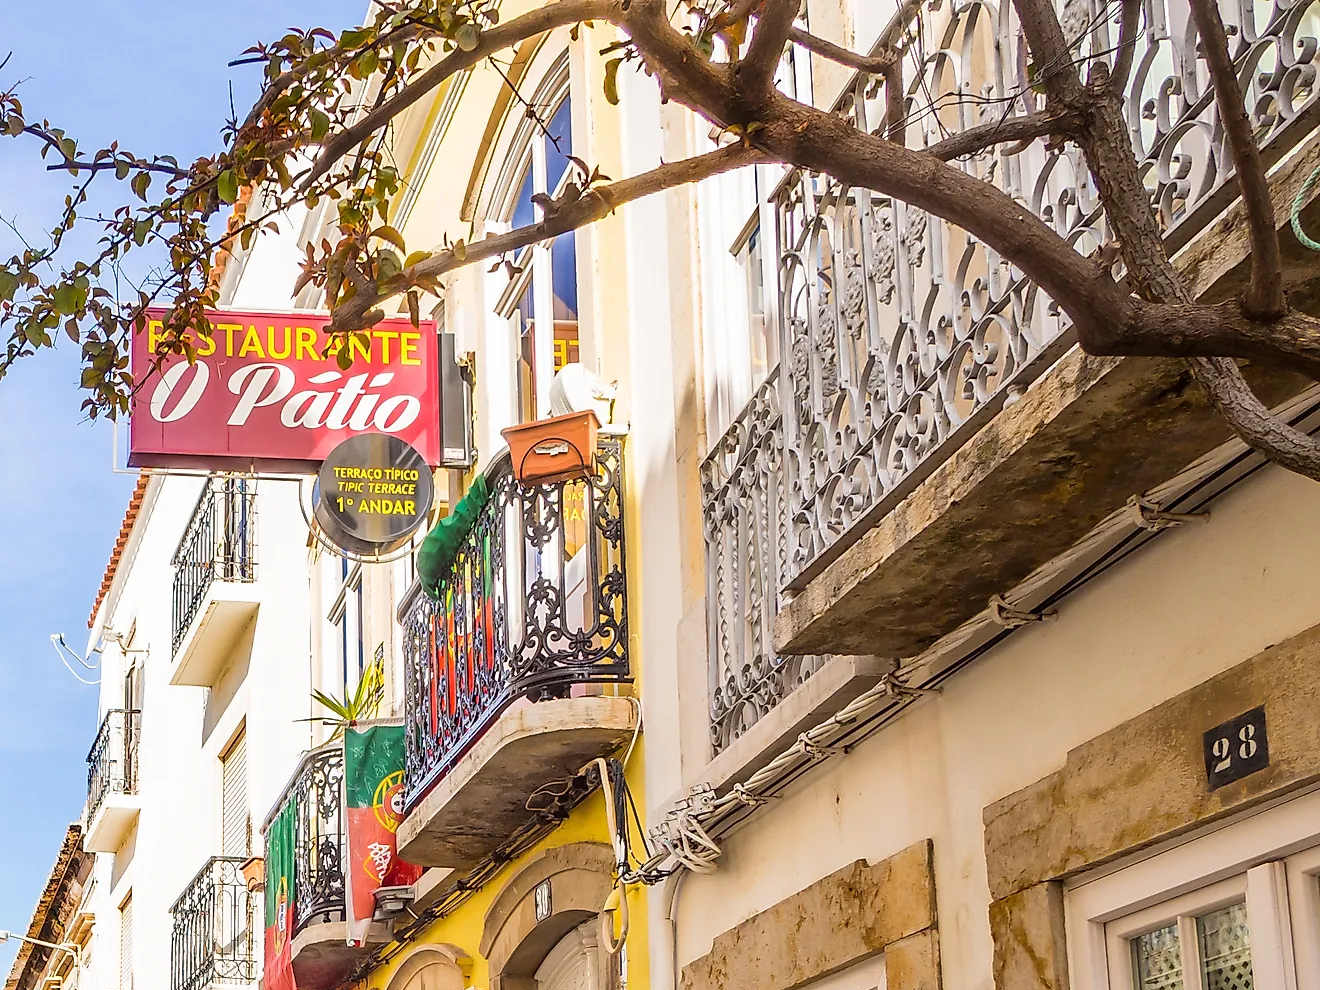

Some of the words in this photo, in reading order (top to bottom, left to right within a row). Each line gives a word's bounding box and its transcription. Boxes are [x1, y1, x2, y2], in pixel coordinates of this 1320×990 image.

[150, 362, 209, 423] O
[228, 363, 421, 432] Pátio
[334, 467, 383, 482] TERRAÇO
[384, 467, 419, 481] TÍPICO
[338, 482, 364, 494] TIPIC
[368, 482, 416, 495] TERRACE
[360, 498, 416, 516] ANDAR
[1213, 724, 1257, 773] 28
